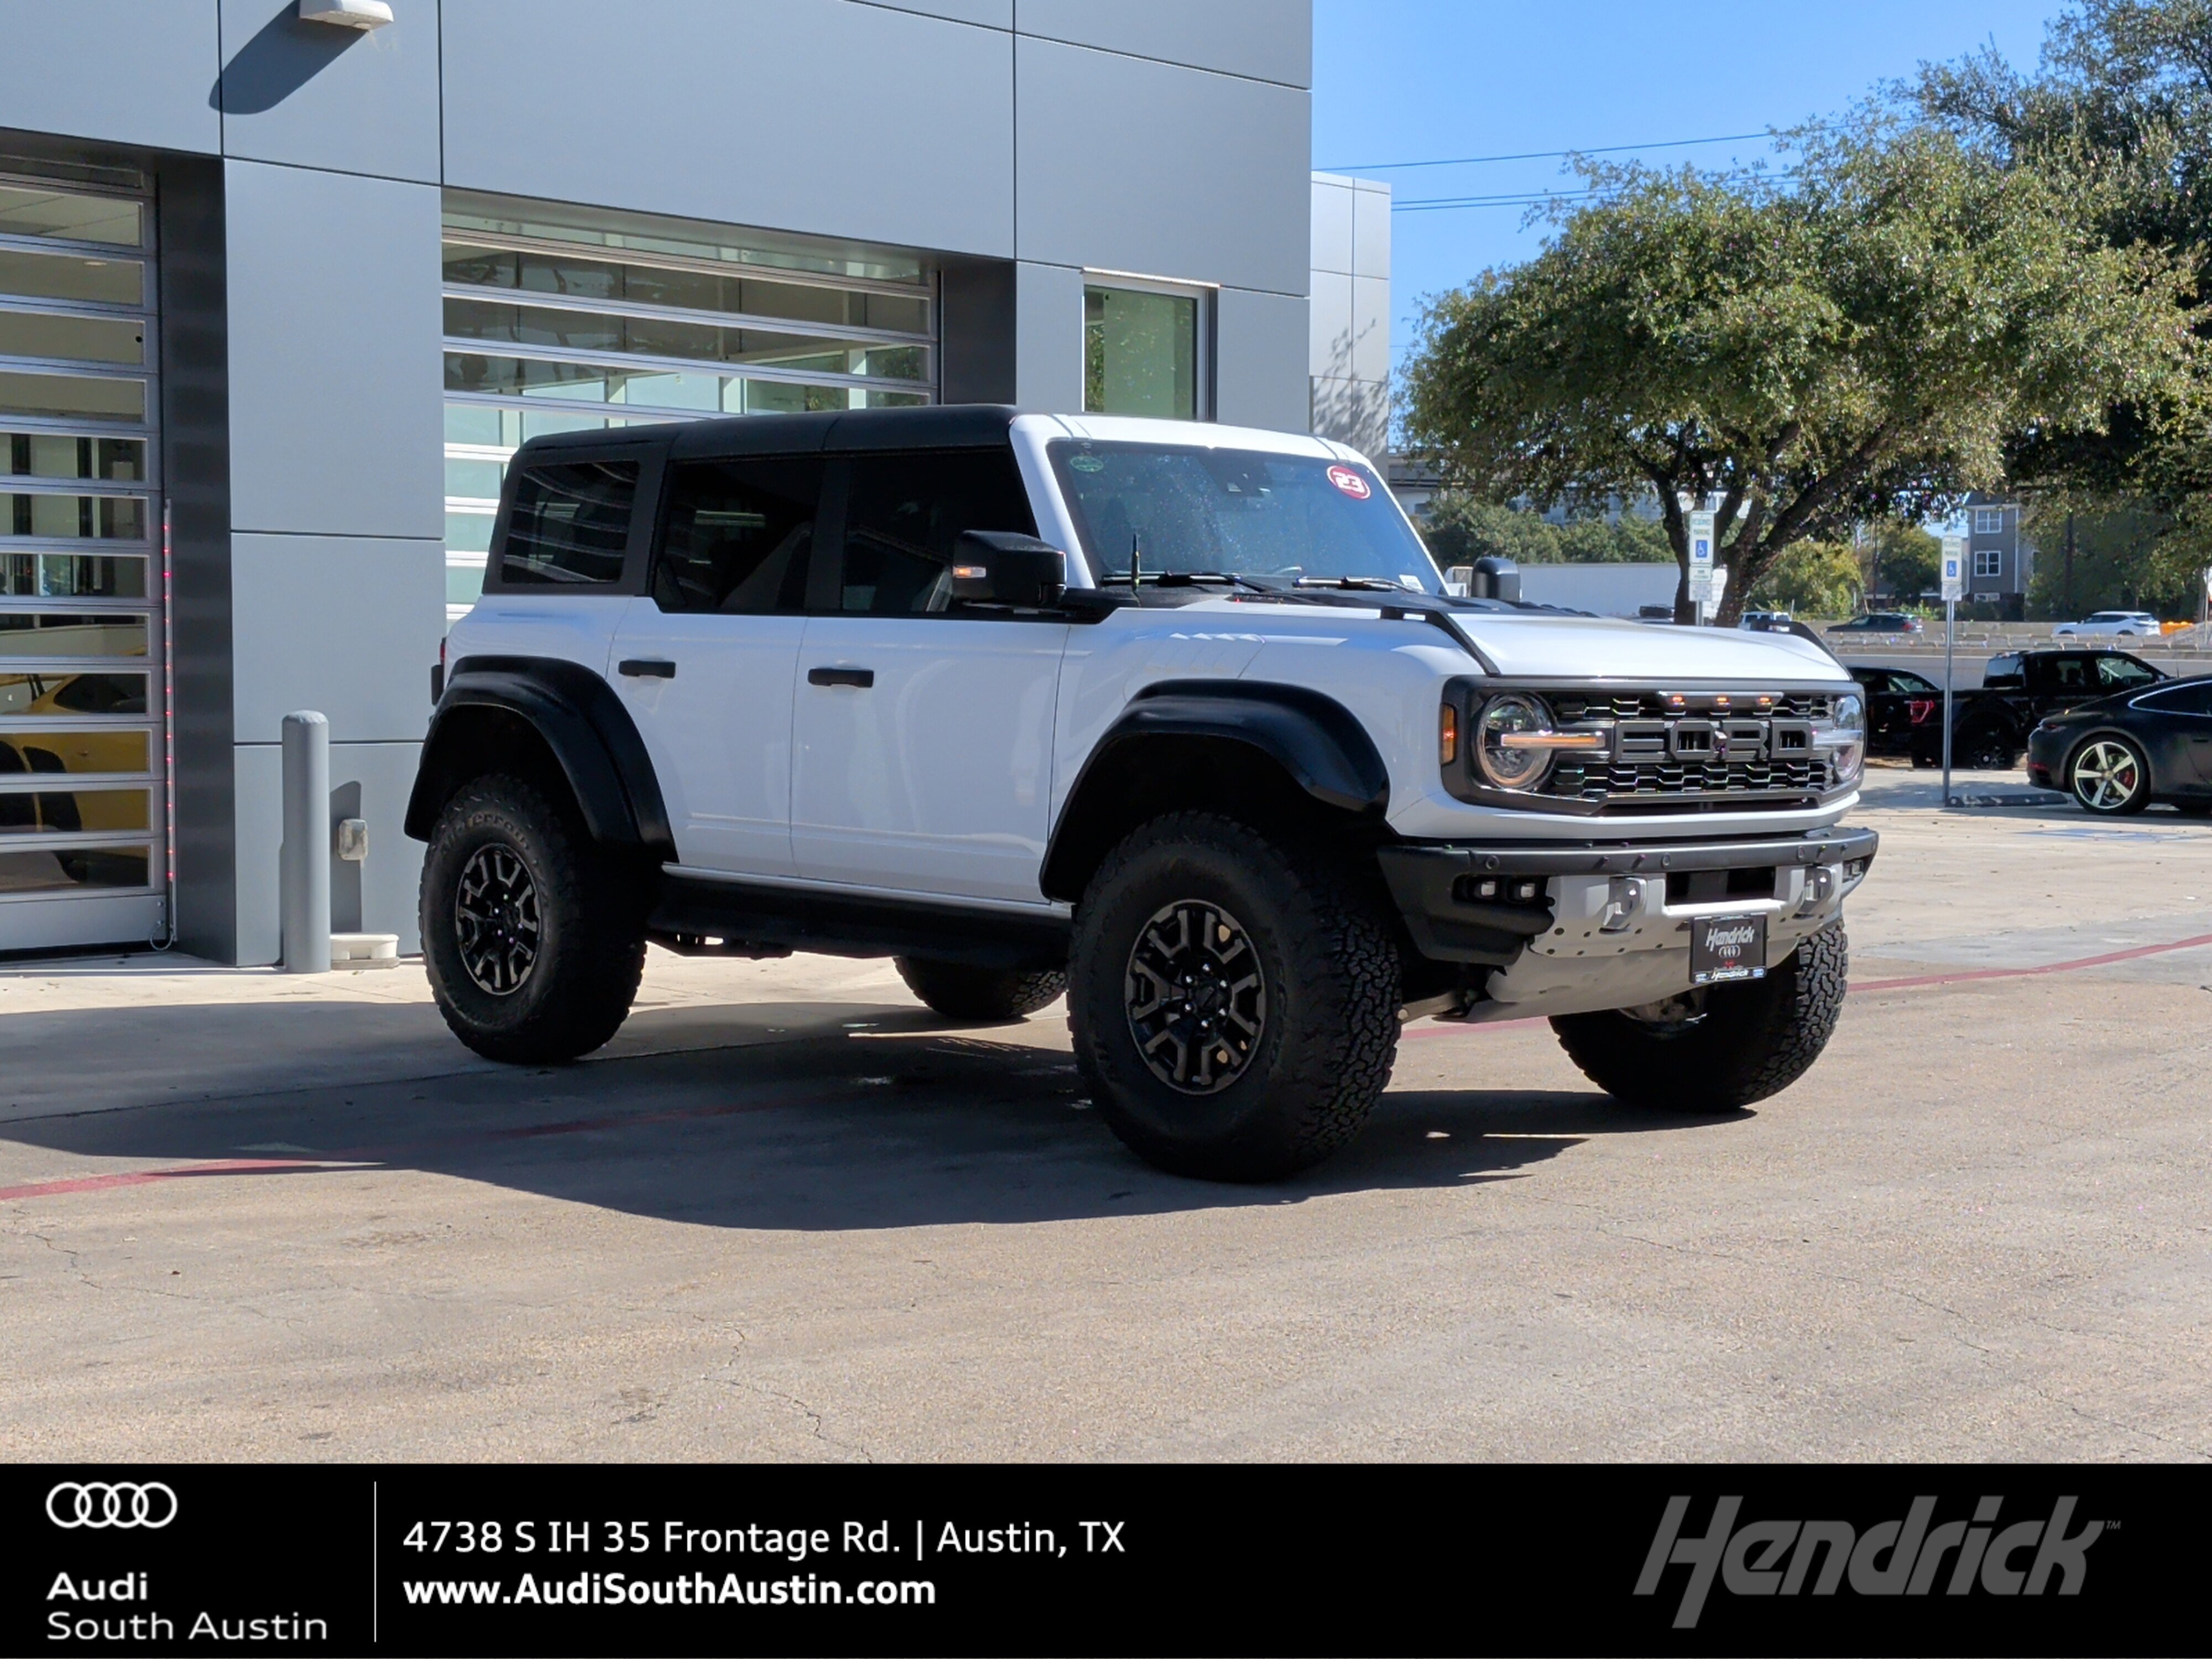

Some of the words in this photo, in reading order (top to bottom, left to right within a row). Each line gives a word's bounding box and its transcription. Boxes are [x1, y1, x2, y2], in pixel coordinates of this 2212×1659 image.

[1333, 471, 1365, 493] 23
[1614, 719, 1813, 761] FORD
[1705, 926, 1755, 952] Hendrick
